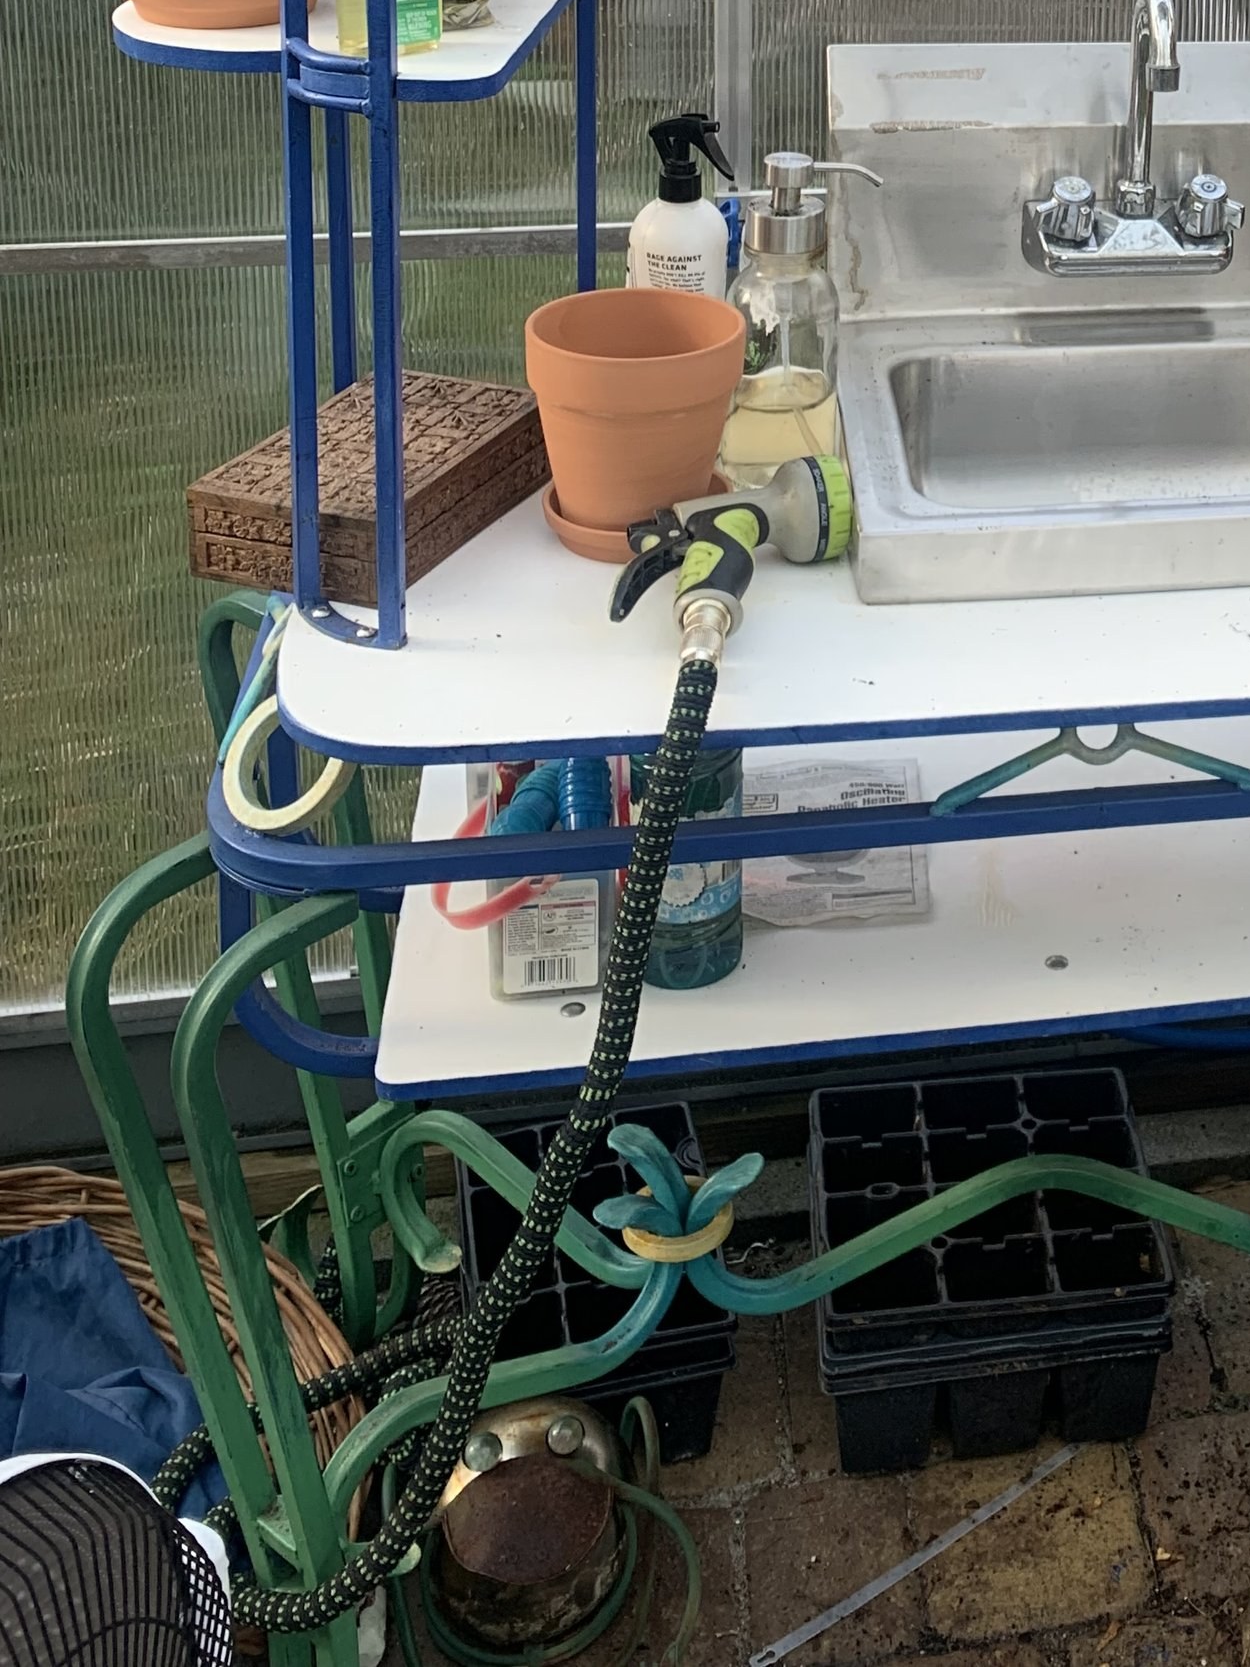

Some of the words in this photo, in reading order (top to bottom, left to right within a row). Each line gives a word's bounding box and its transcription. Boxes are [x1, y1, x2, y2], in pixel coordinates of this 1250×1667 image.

[667, 254, 703, 263] AGAINST
[648, 259, 660, 269] THE
[662, 263, 687, 271] CLEAN
[840, 788, 906, 801] Oscillating
[862, 794, 906, 807] Heater
